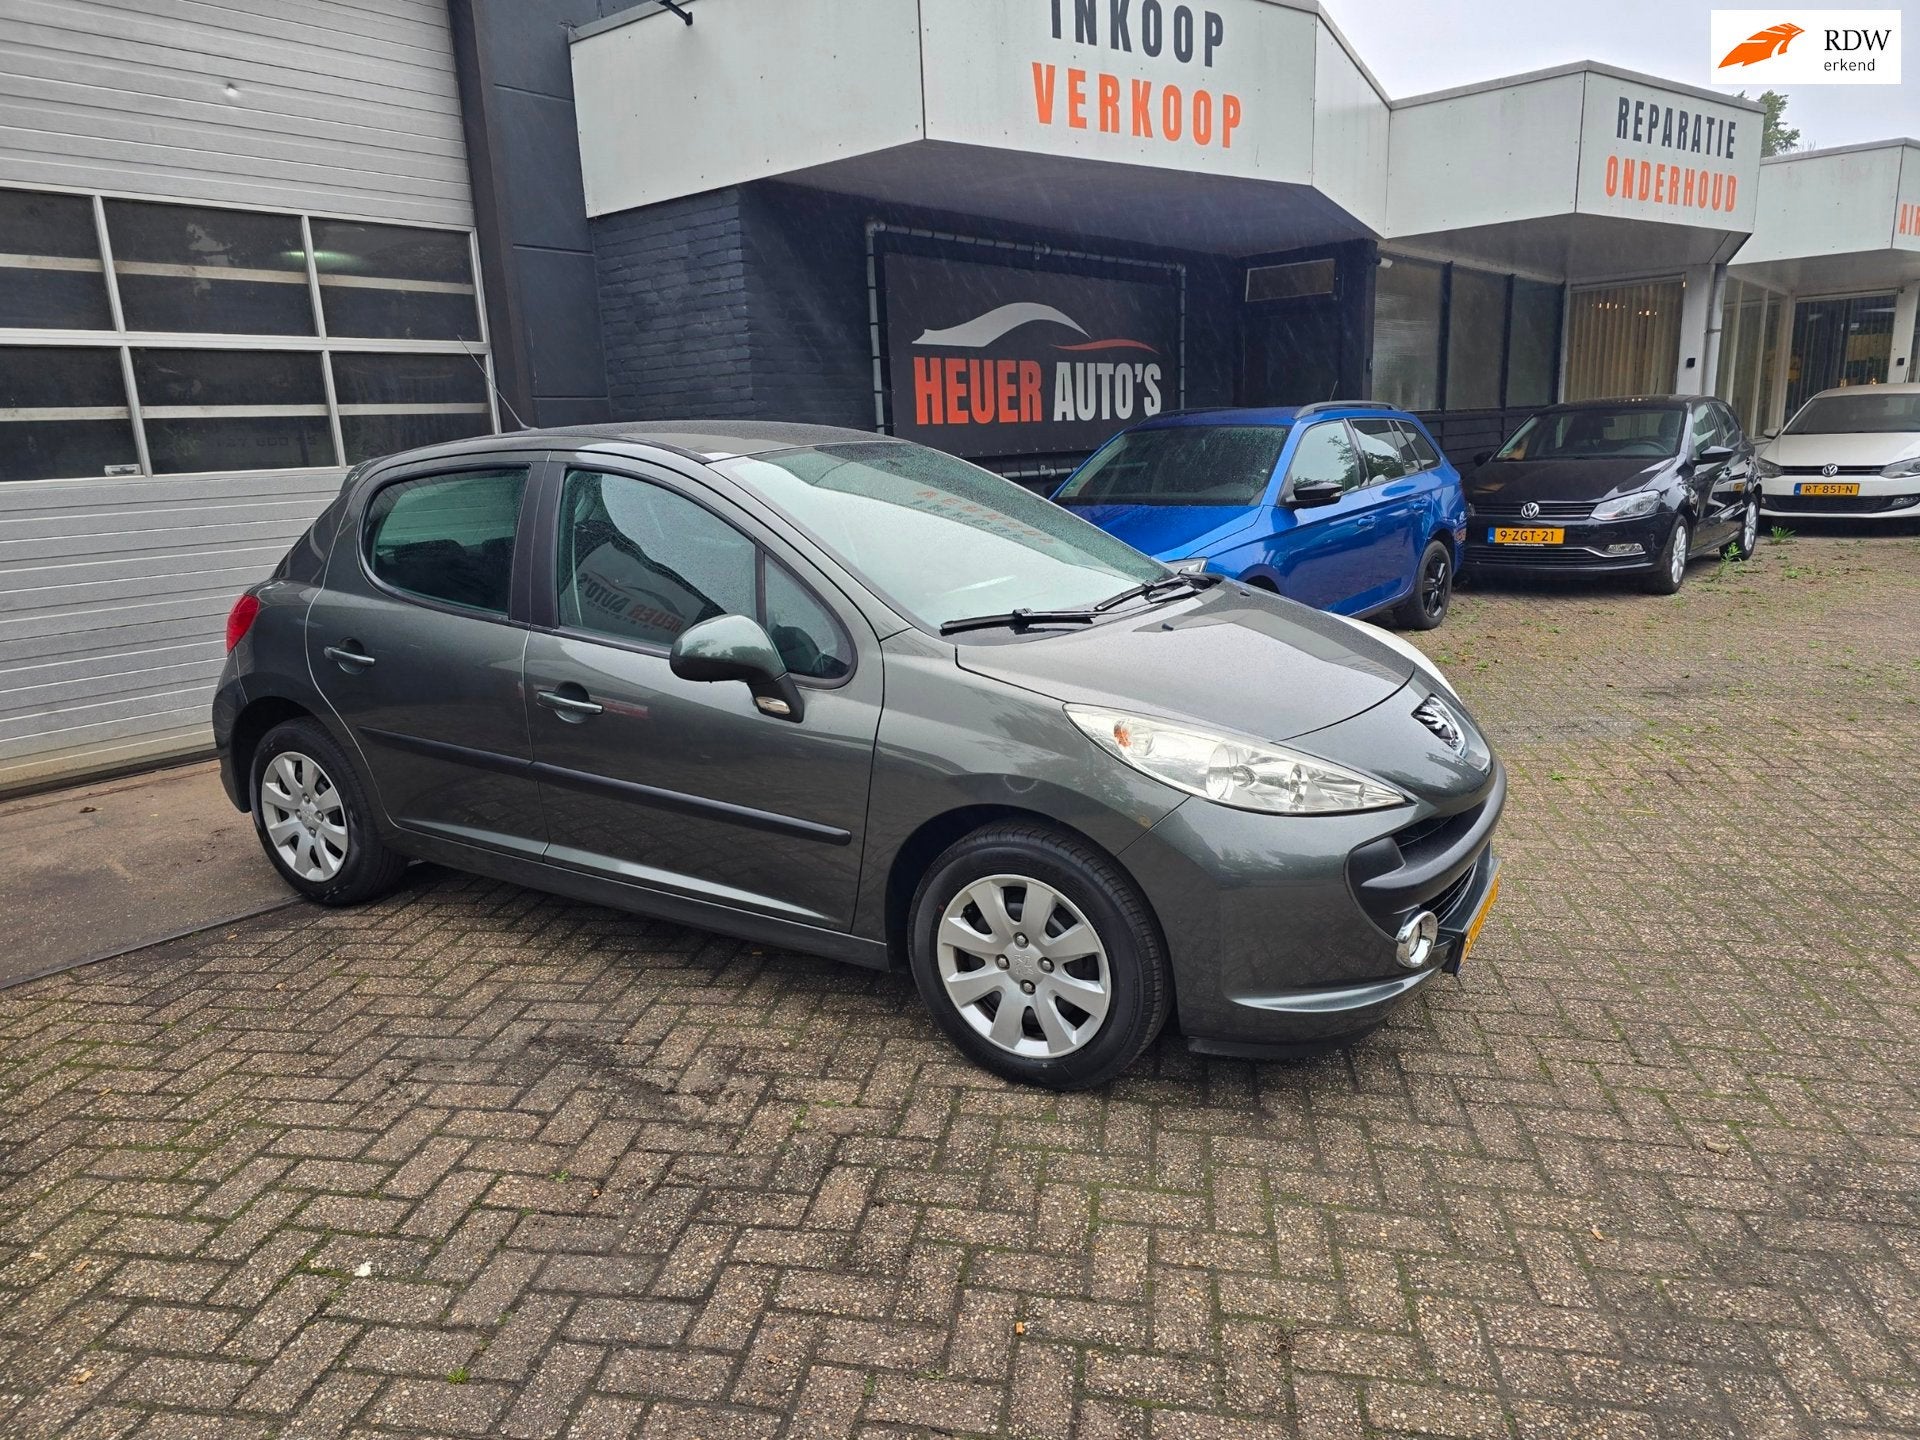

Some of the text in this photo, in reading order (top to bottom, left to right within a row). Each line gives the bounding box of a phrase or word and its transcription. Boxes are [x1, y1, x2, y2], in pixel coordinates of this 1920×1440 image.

[1051, 0, 1224, 67] INKOOP
[1031, 62, 1241, 148] VERKOOP
[1616, 96, 1736, 159] REPARATIE
[1605, 155, 1737, 213] ONDERHOUD
[913, 356, 1162, 425] HEUER AUTO'S
[1805, 485, 1853, 494] RT-851-N
[1500, 530, 1555, 542] 9-ZGT-21
